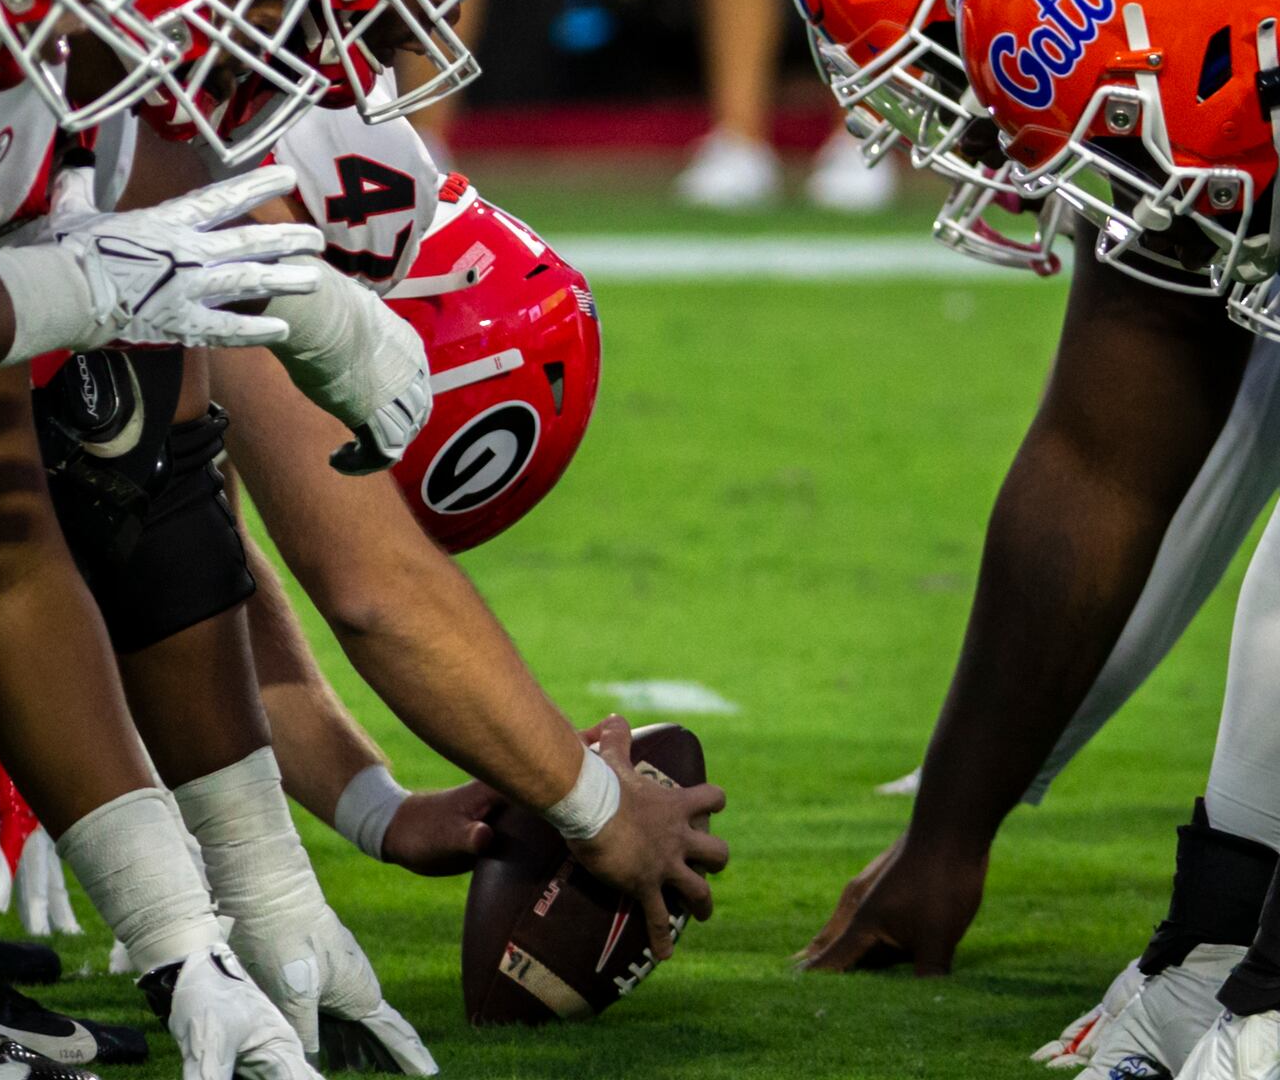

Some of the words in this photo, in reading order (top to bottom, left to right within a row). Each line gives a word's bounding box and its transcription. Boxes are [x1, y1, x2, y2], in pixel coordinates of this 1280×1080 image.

[314, 153, 417, 284] 47
[76, 353, 100, 420] DONJOY
[428, 425, 522, 513] G
